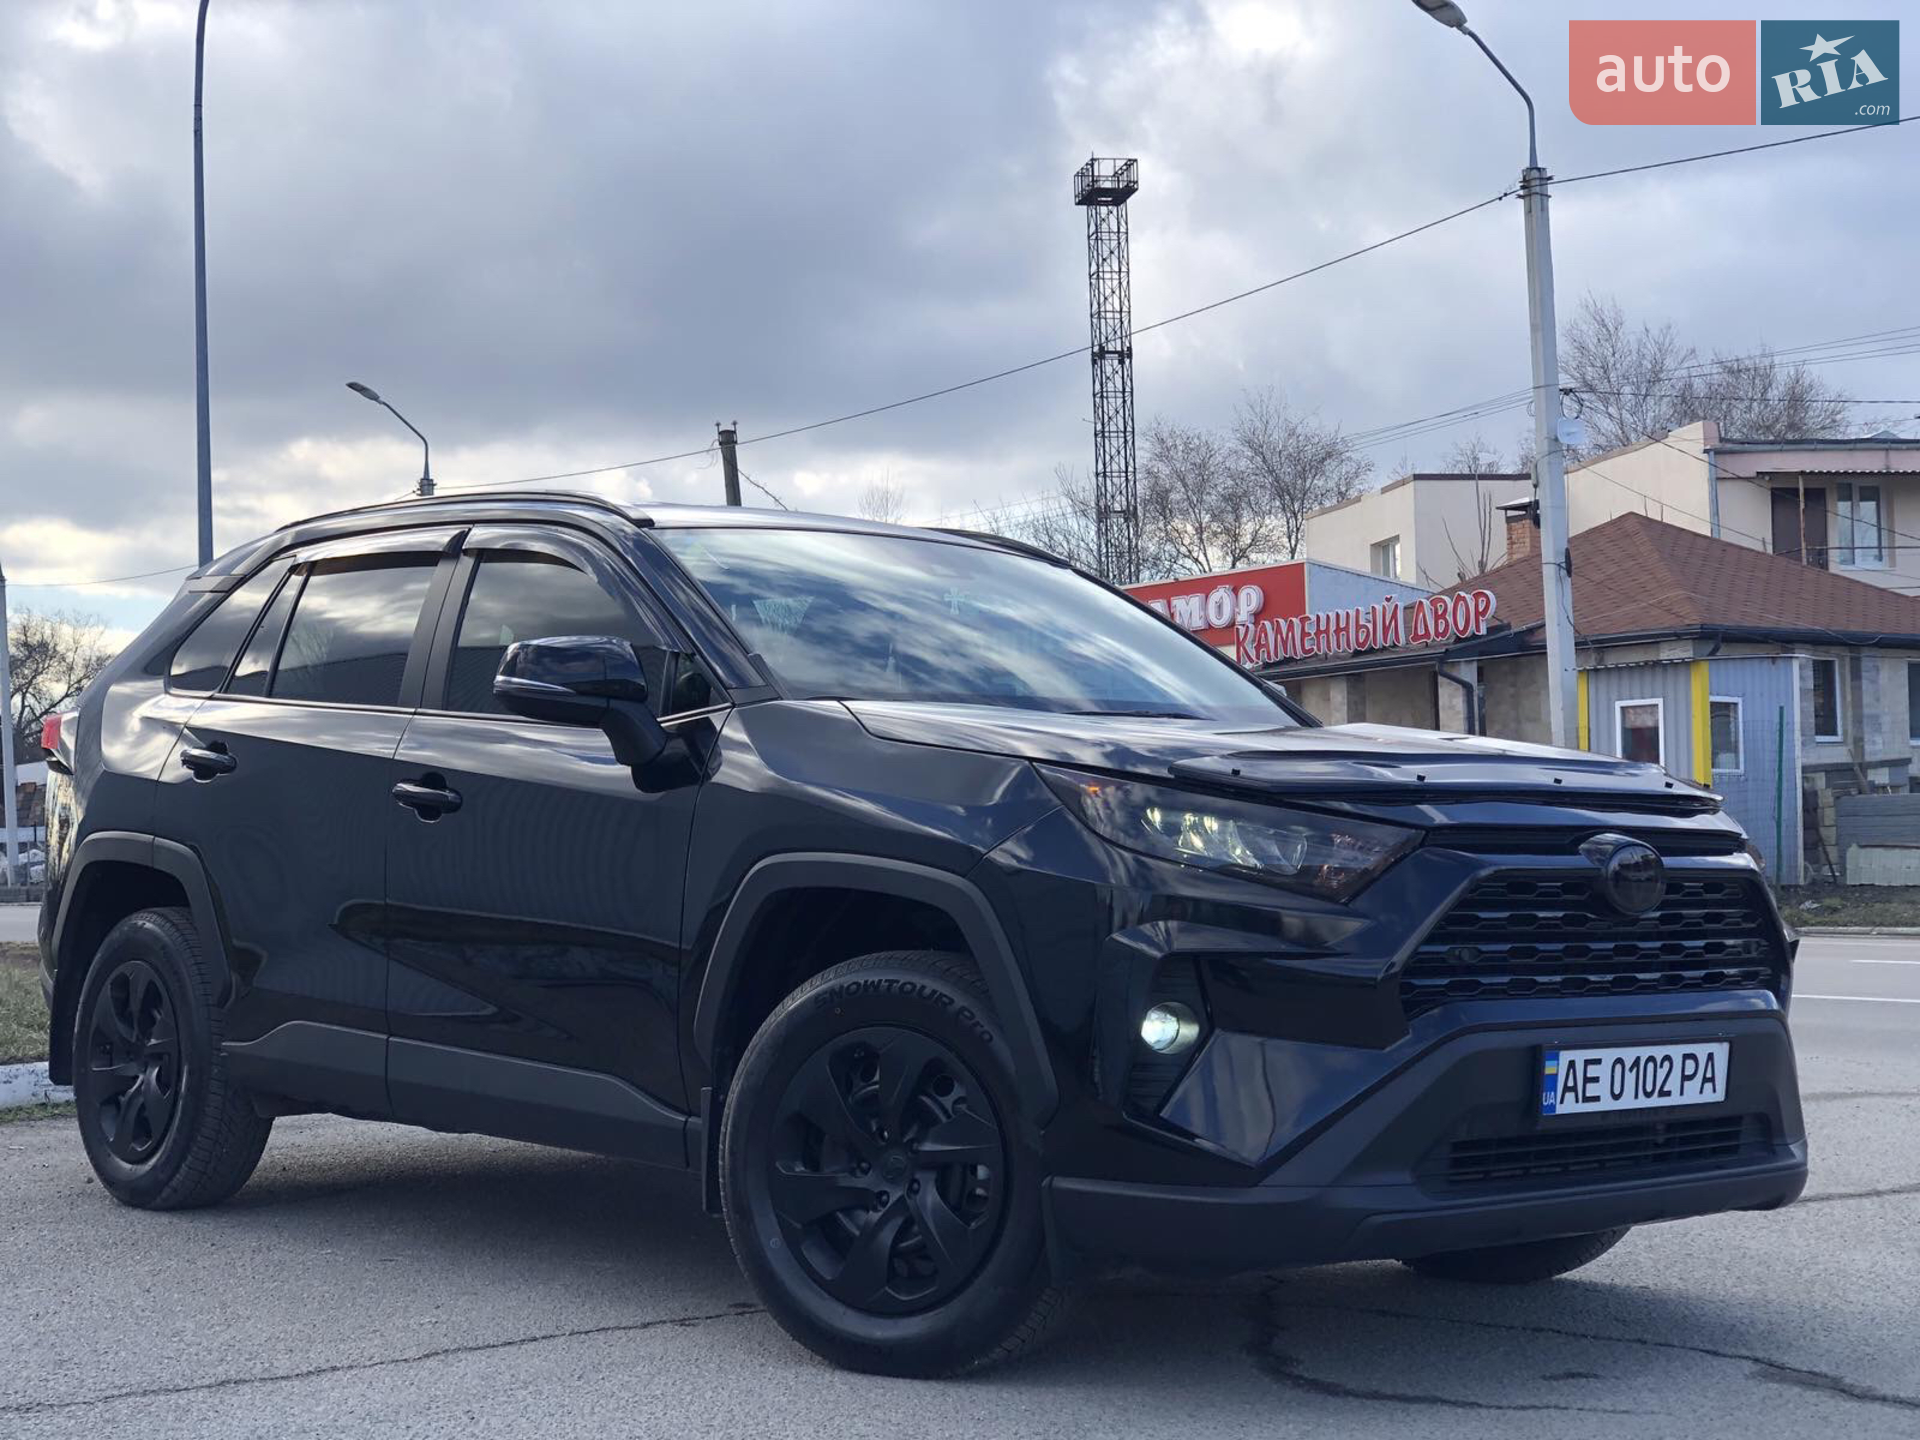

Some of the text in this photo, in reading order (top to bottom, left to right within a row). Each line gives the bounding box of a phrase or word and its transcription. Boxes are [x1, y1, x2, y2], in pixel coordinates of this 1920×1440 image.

[1235, 590, 1497, 669] КАМЕННЫЙ ДВОР
[814, 978, 956, 1010] SNOWTOUR
[1543, 1091, 1556, 1106] UA
[1559, 1051, 1717, 1105] AE 0102 PA
